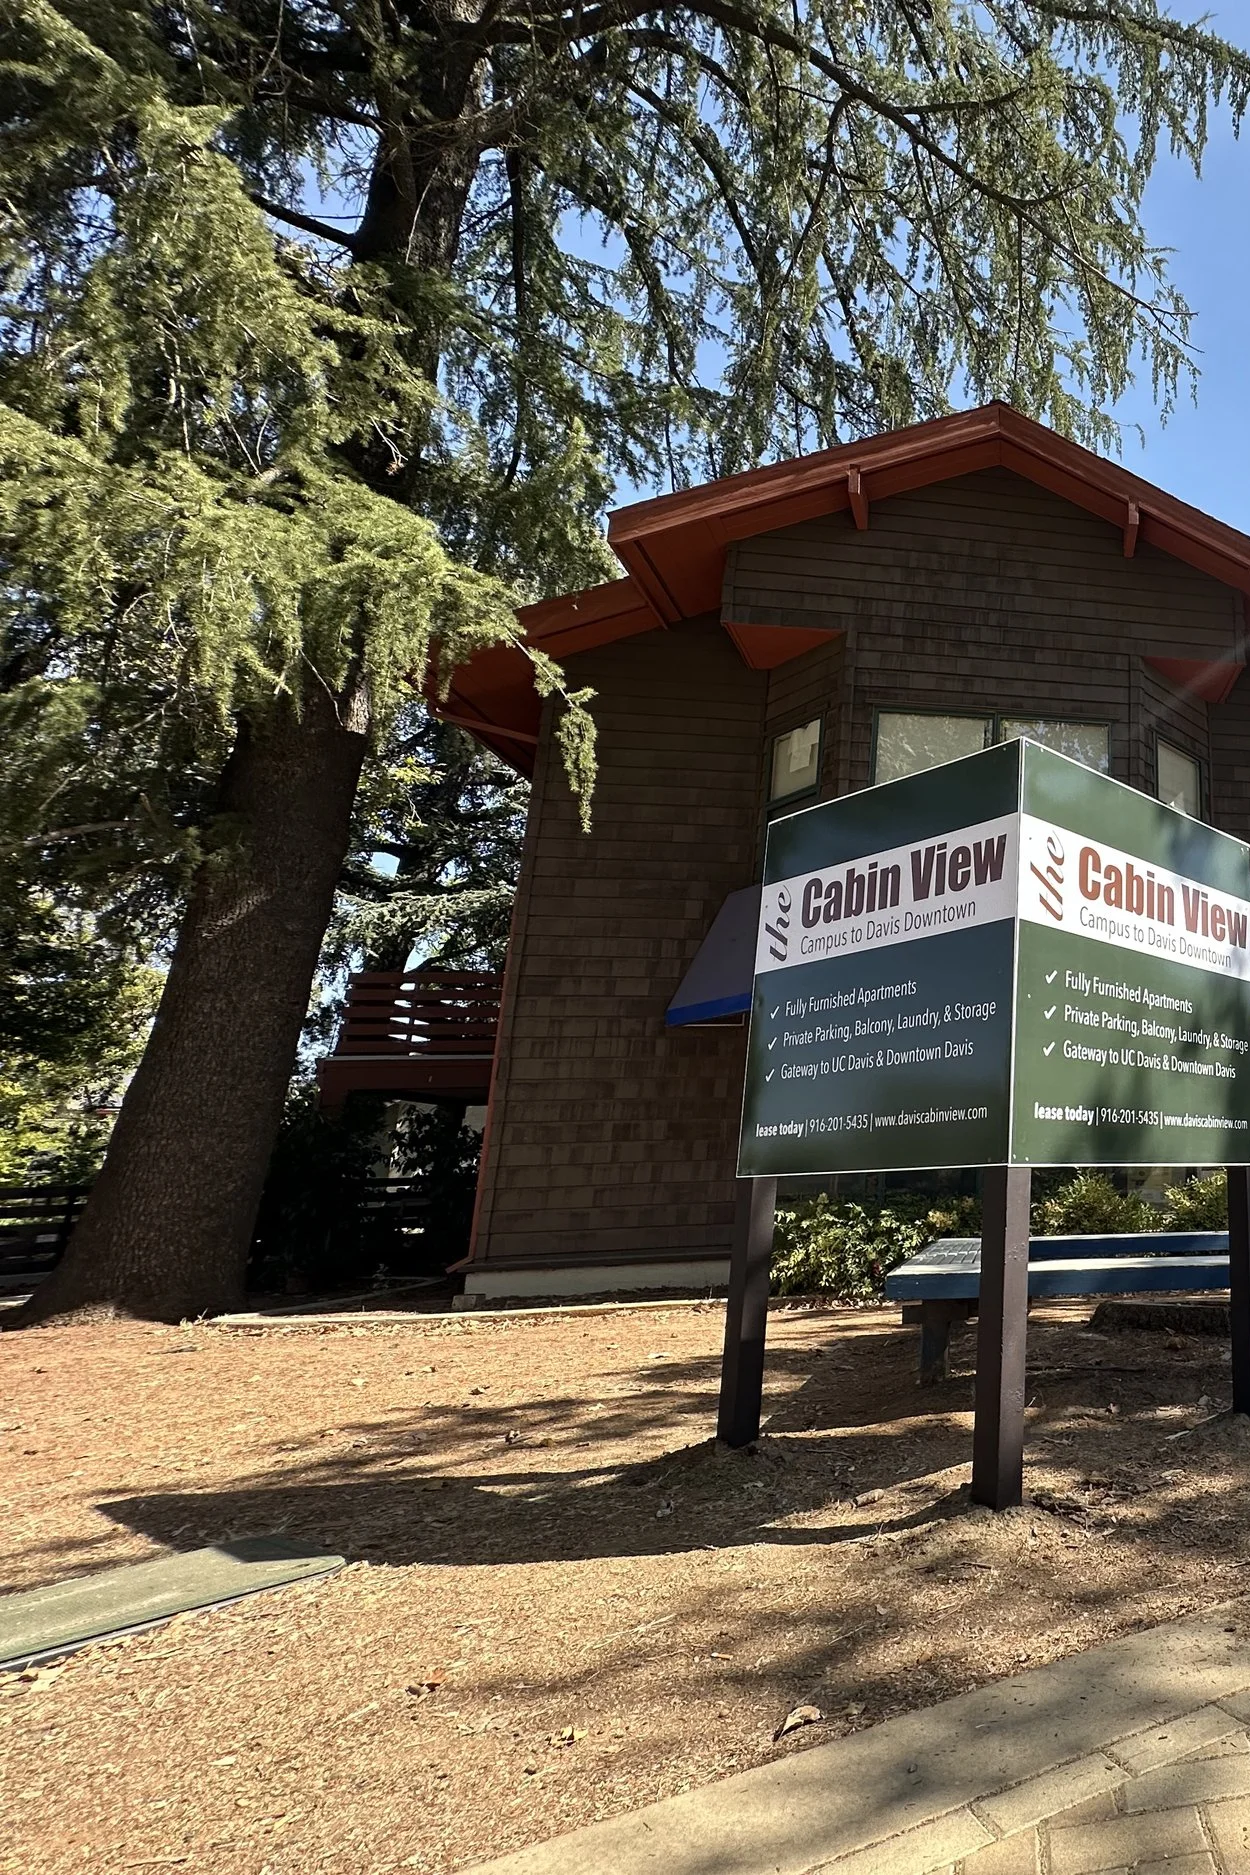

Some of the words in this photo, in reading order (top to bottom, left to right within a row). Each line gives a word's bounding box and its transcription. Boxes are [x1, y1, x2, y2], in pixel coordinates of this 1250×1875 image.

[801, 860, 901, 929] Cabin
[910, 833, 1007, 902] View
[1030, 829, 1065, 922] the
[1078, 846, 1175, 927] Cabin
[1181, 883, 1248, 950] View
[765, 885, 792, 962] the
[800, 931, 848, 956] Campus
[850, 926, 863, 944] to
[866, 915, 900, 941] Davis
[904, 900, 976, 932] Downtown
[1079, 906, 1131, 940] Campus
[1133, 924, 1145, 943] to
[1148, 926, 1177, 953] Davis
[1179, 936, 1232, 968] Downtown
[785, 998, 808, 1019] Fully
[808, 987, 856, 1013] Furnished
[857, 980, 917, 1007] Apartments
[1065, 969, 1091, 997] Fully
[1093, 976, 1141, 1003] Furnished
[1142, 987, 1193, 1014] Apartments
[783, 1030, 813, 1047] Private
[815, 1023, 852, 1043] Parking,
[854, 1017, 895, 1036] Balcony,
[897, 1007, 941, 1029] Laundry,
[943, 1004, 952, 1023] &
[954, 1001, 997, 1021] Storage
[1064, 1004, 1100, 1027] Private
[1101, 1011, 1140, 1038] Parking,
[1141, 1018, 1177, 1044] Balcony,
[1178, 1026, 1212, 1050] Laundry,
[1213, 1032, 1220, 1048] &
[1220, 1033, 1249, 1055] Storage
[780, 1062, 819, 1080] Gateway
[820, 1059, 830, 1075] to
[831, 1055, 846, 1073] UC
[848, 1052, 874, 1071] Davis
[876, 1049, 884, 1068] &
[886, 1047, 942, 1066] Downtown
[944, 1038, 974, 1058] Davis
[1063, 1040, 1107, 1068] Gateway
[1109, 1048, 1119, 1065] to
[1121, 1049, 1136, 1066] UC
[1137, 1050, 1161, 1070] Davis
[1162, 1054, 1170, 1071] &
[1171, 1055, 1214, 1076] Downtown
[1215, 1061, 1236, 1079] Davis
[755, 1122, 778, 1138] lease
[779, 1120, 804, 1138] today
[809, 1112, 869, 1133] 916-201-5435
[874, 1105, 988, 1128] www.daviscabinview.com
[1034, 1102, 1064, 1121] lease
[1064, 1105, 1094, 1126] today
[1100, 1107, 1159, 1126] 916-201-5435
[1164, 1114, 1248, 1131] www.daviscabinview.com
